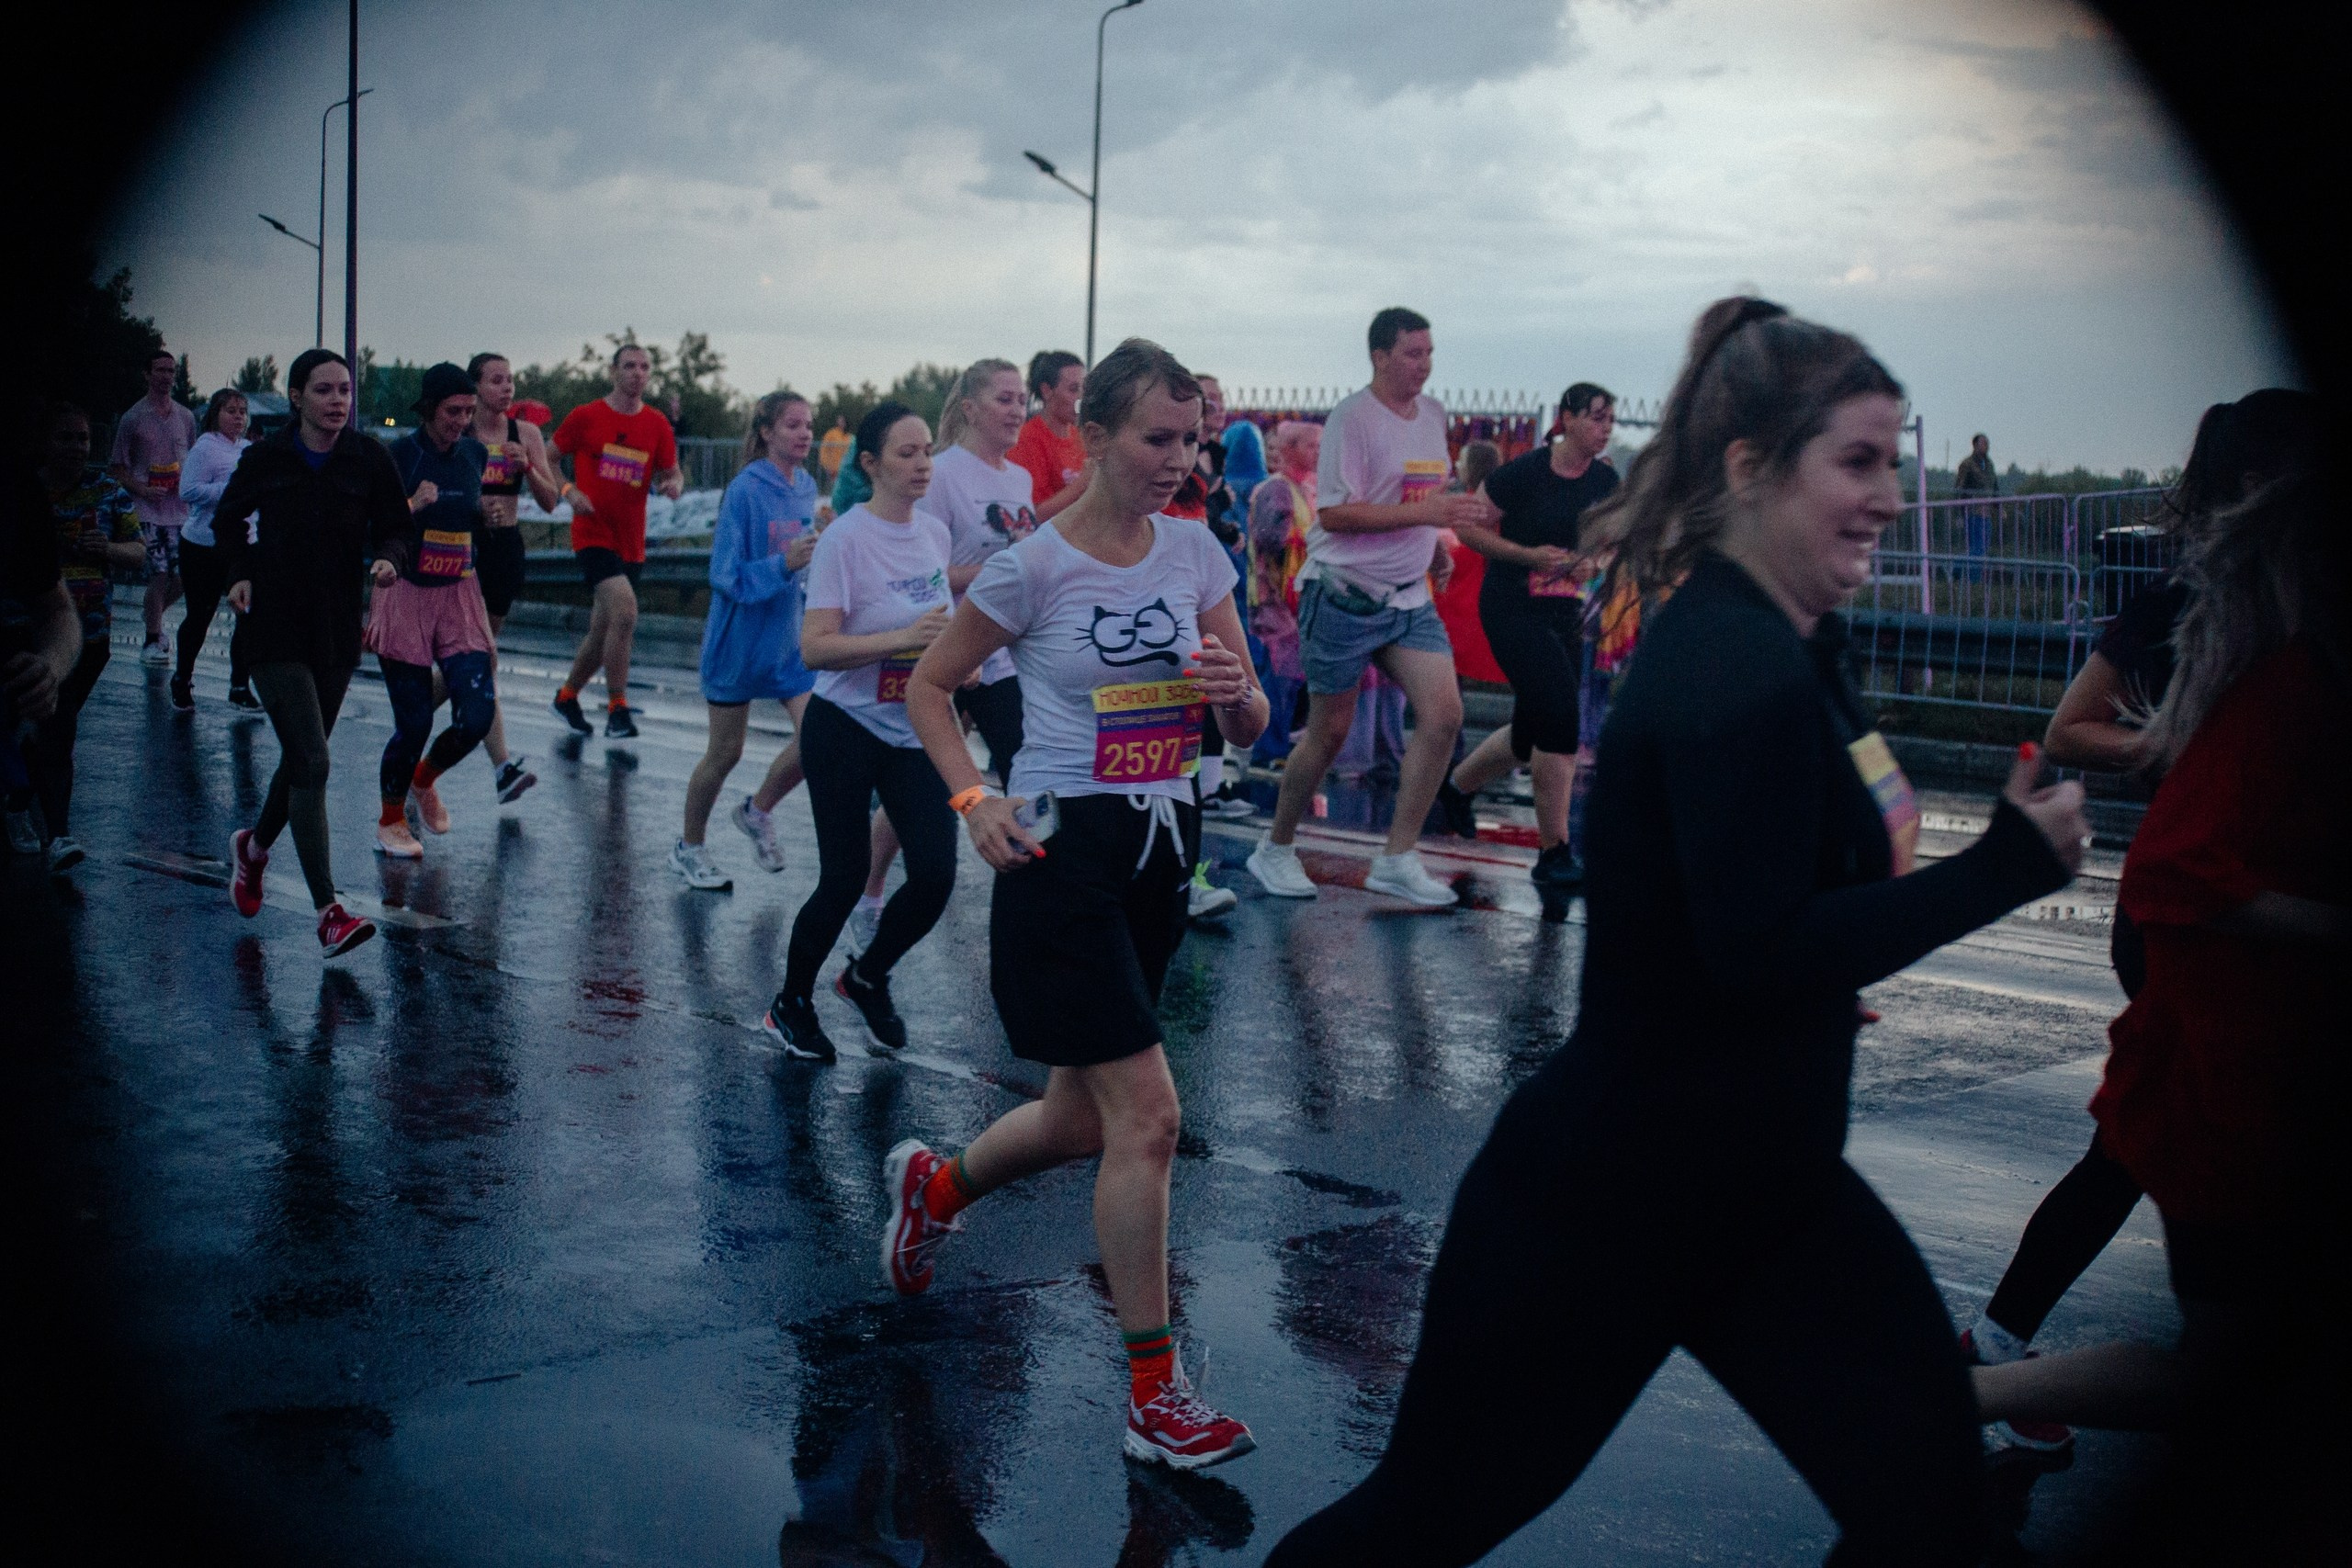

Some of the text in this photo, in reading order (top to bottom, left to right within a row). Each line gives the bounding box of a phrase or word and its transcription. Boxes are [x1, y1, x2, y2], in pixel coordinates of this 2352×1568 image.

[423, 555, 463, 573] 2077
[1099, 687, 1159, 706] НОЧНОЙ
[1102, 737, 1182, 776] 2597
